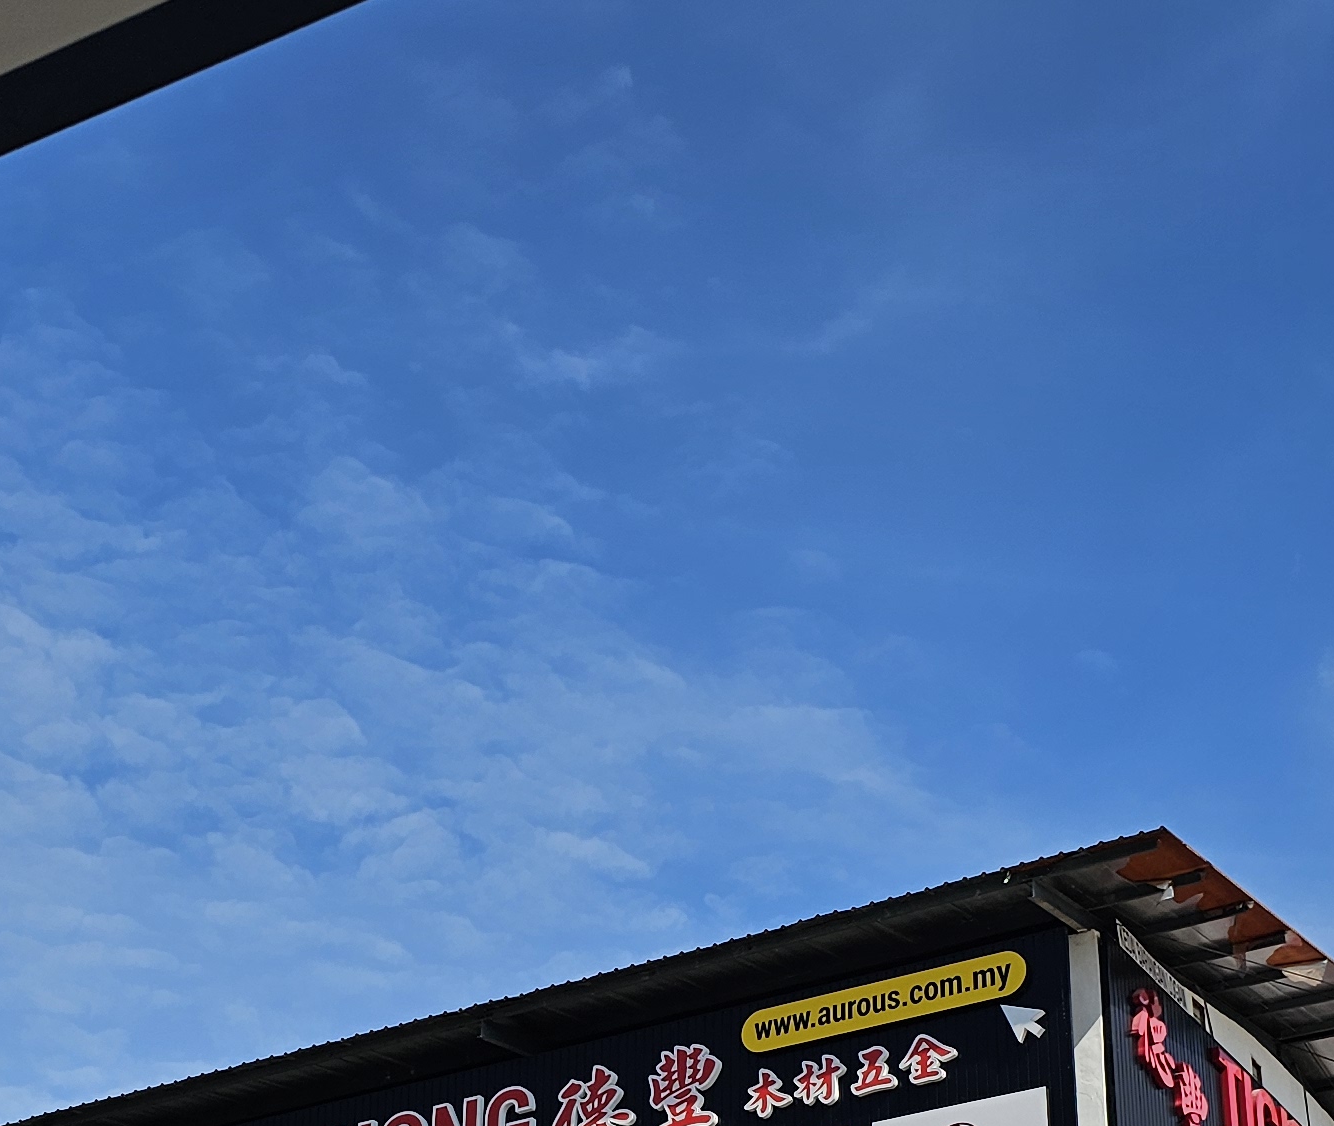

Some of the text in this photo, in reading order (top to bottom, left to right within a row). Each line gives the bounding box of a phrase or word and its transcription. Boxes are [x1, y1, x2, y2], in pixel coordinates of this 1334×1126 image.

[754, 962, 1012, 1040] www.aurous.com.my
[744, 1034, 958, 1119] 木材五金
